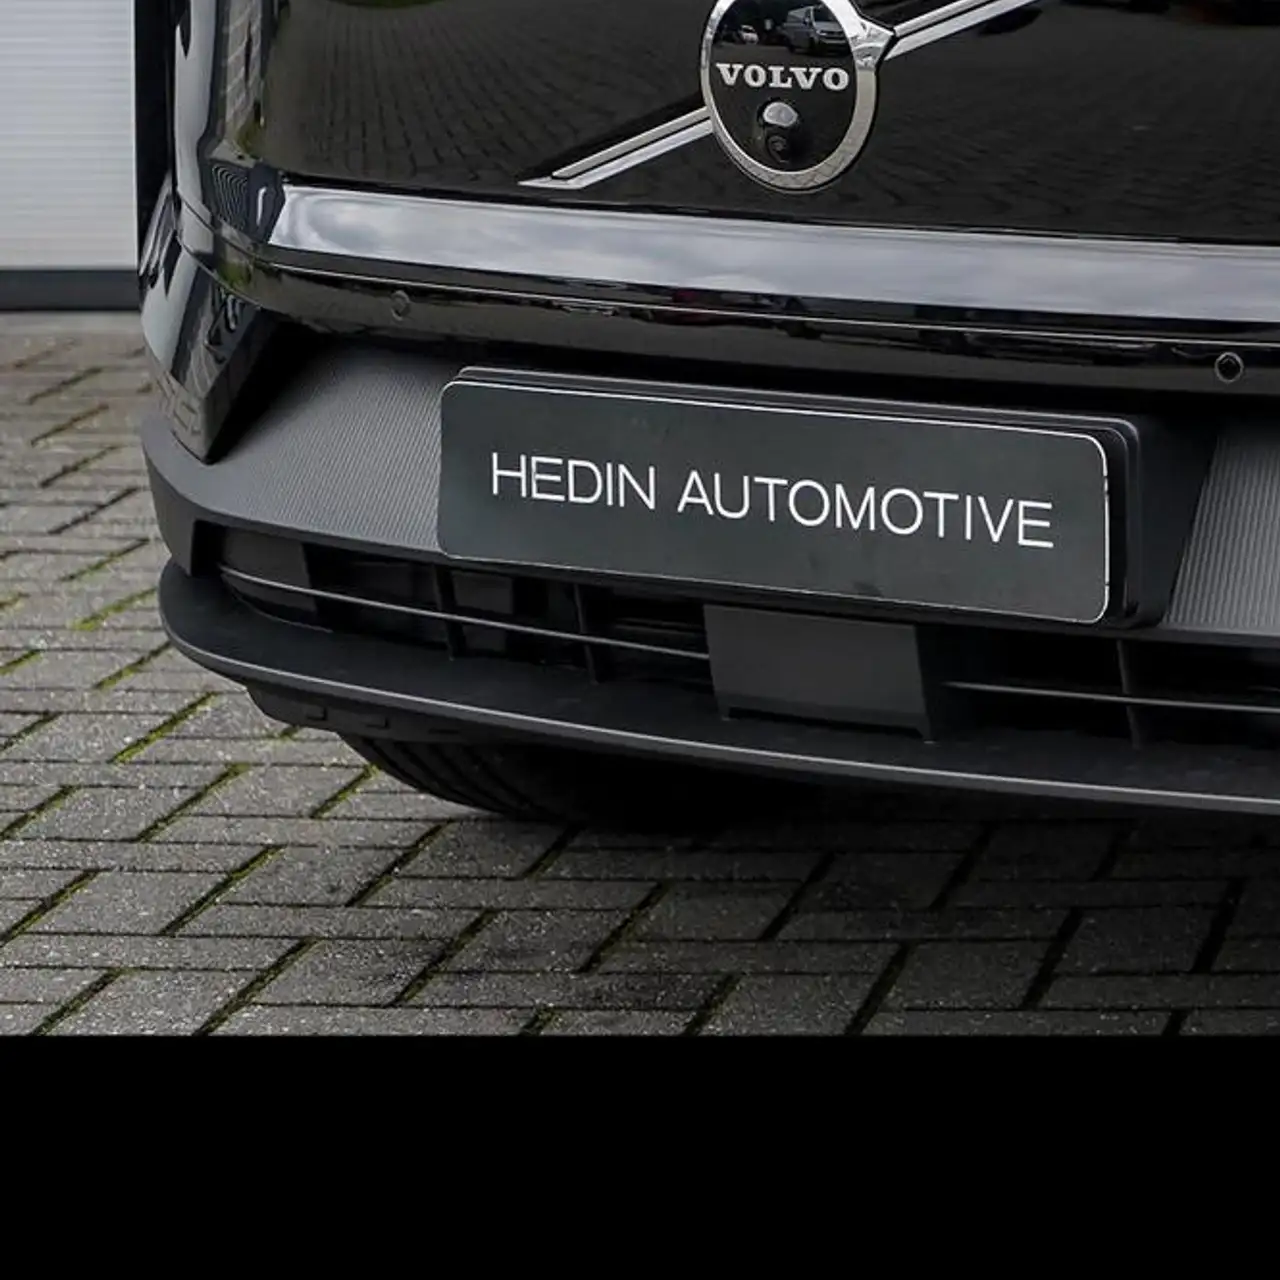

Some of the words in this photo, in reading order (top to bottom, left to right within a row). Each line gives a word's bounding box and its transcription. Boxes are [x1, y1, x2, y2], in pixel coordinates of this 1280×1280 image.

[715, 62, 850, 92] VOLVO
[491, 452, 657, 510] HEDIN
[677, 470, 1055, 549] AUTOMOTIVE
